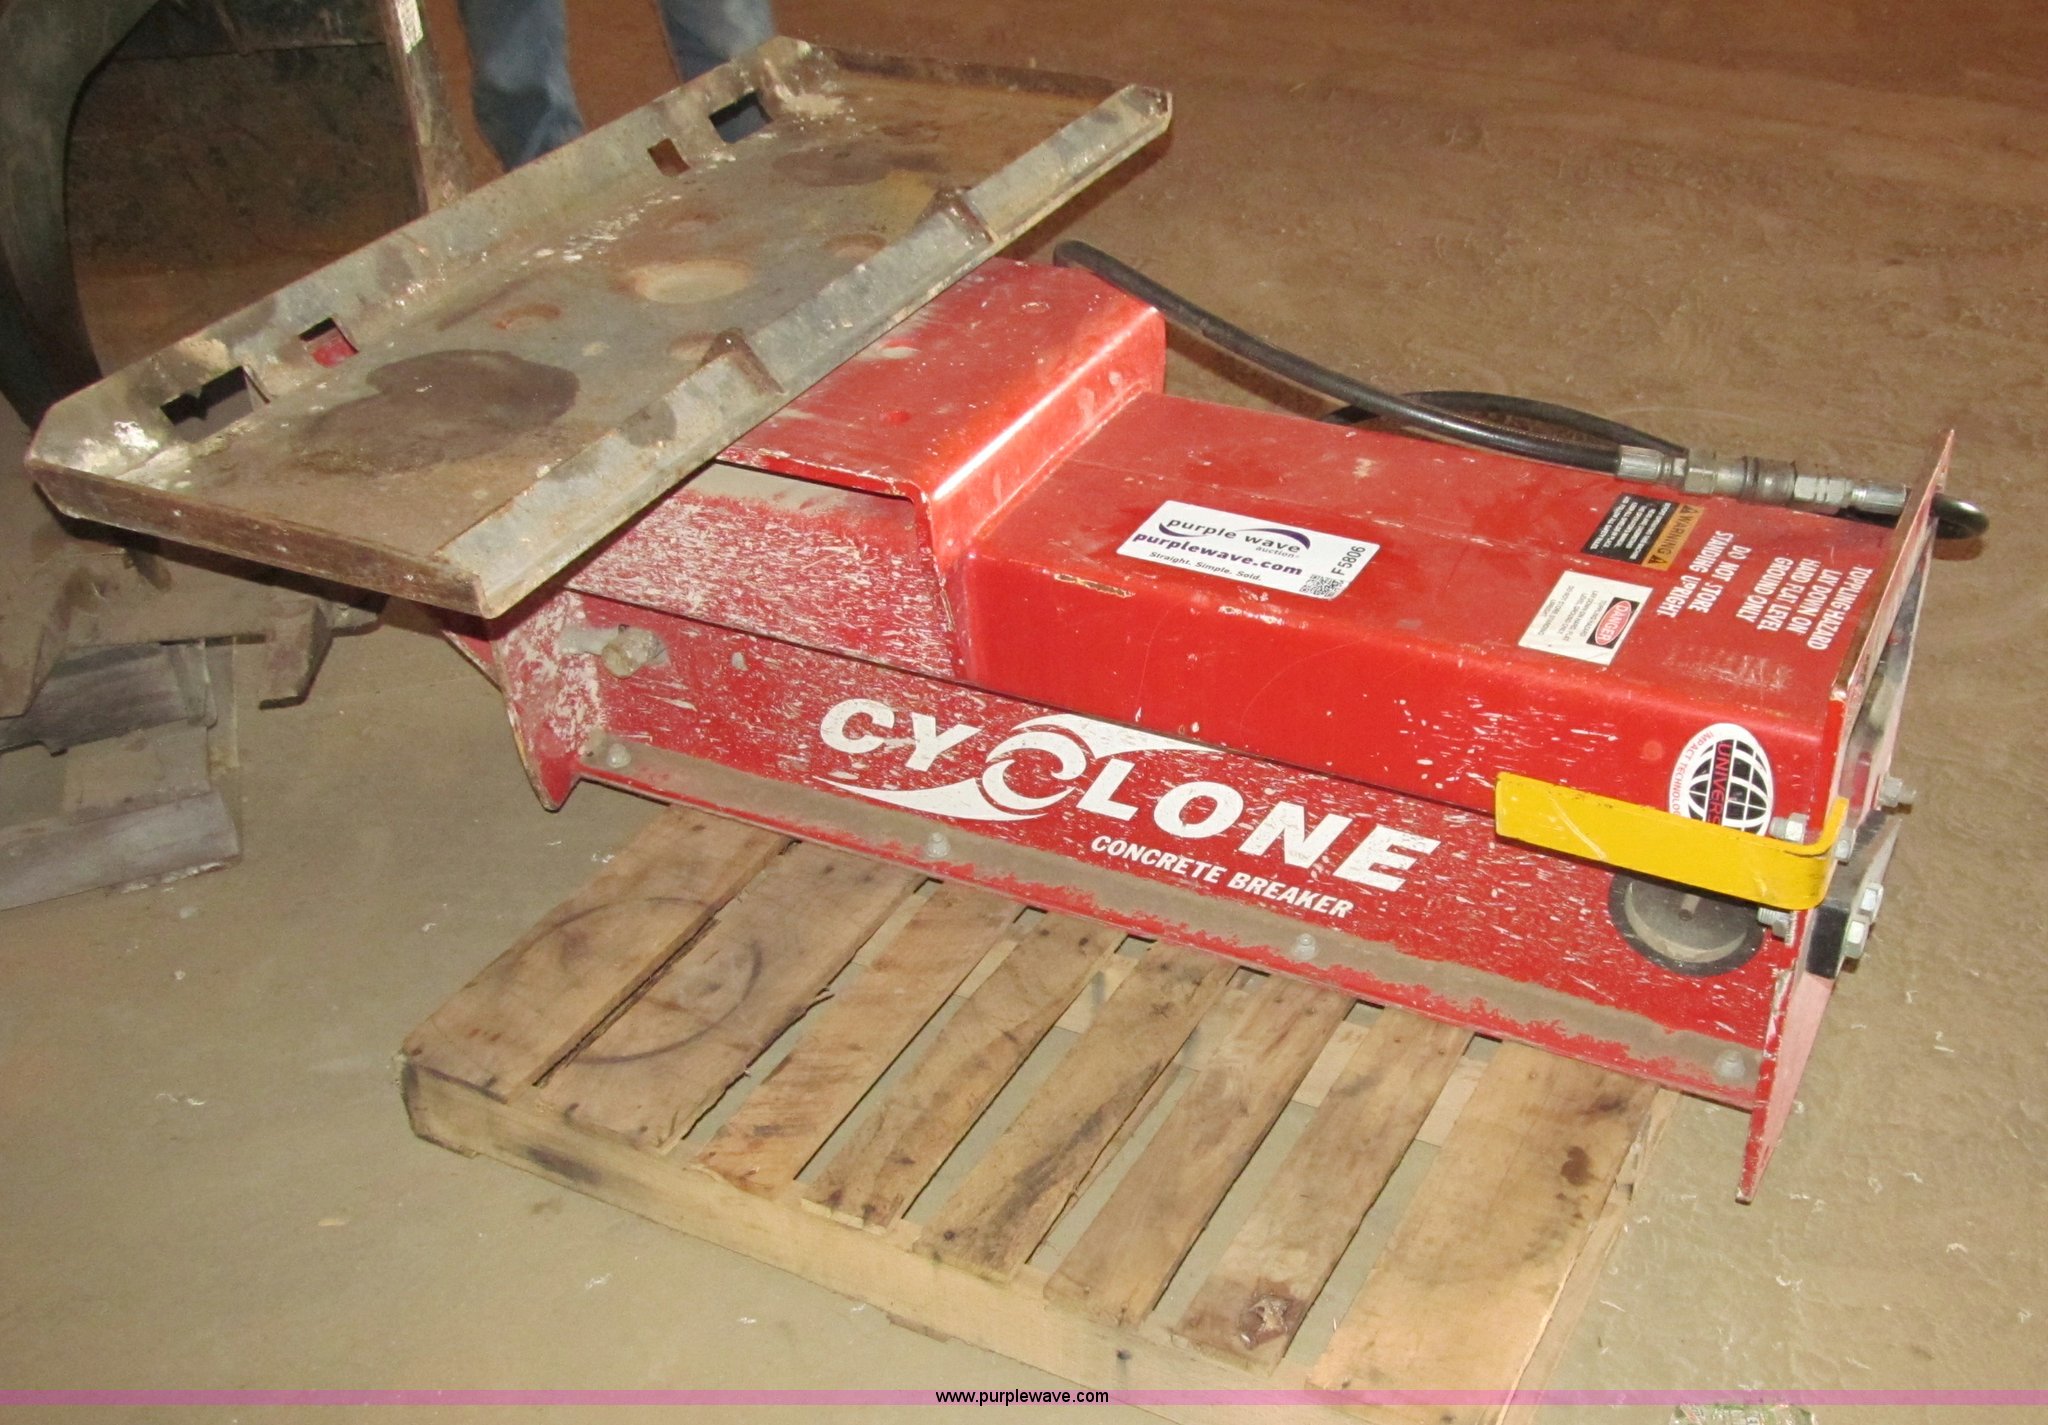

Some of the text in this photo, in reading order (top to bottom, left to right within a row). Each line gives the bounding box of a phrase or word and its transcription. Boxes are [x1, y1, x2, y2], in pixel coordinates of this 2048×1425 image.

[1132, 533, 1303, 576] purplewave.com
[1149, 551, 1262, 581] Straight. Simple. Sold.
[1166, 519, 1301, 553] purple wave
[1657, 513, 1694, 555] WARNING
[1656, 530, 1734, 618] STANDING UPRIGHT
[1687, 544, 1752, 613] DO NOT STORE
[1735, 557, 1794, 623] GROUND ONLY
[1756, 558, 1821, 632] HARD FLAT LEVEL
[1786, 568, 1843, 635] LAY DOWN ON
[1597, 604, 1630, 642] DANGER
[1807, 566, 1874, 650] TOPPLING HAZARD
[1685, 730, 1714, 760] IMPACT
[819, 698, 1442, 892] CYCLONE
[1091, 835, 1355, 918] CONCRETE BREAKER
